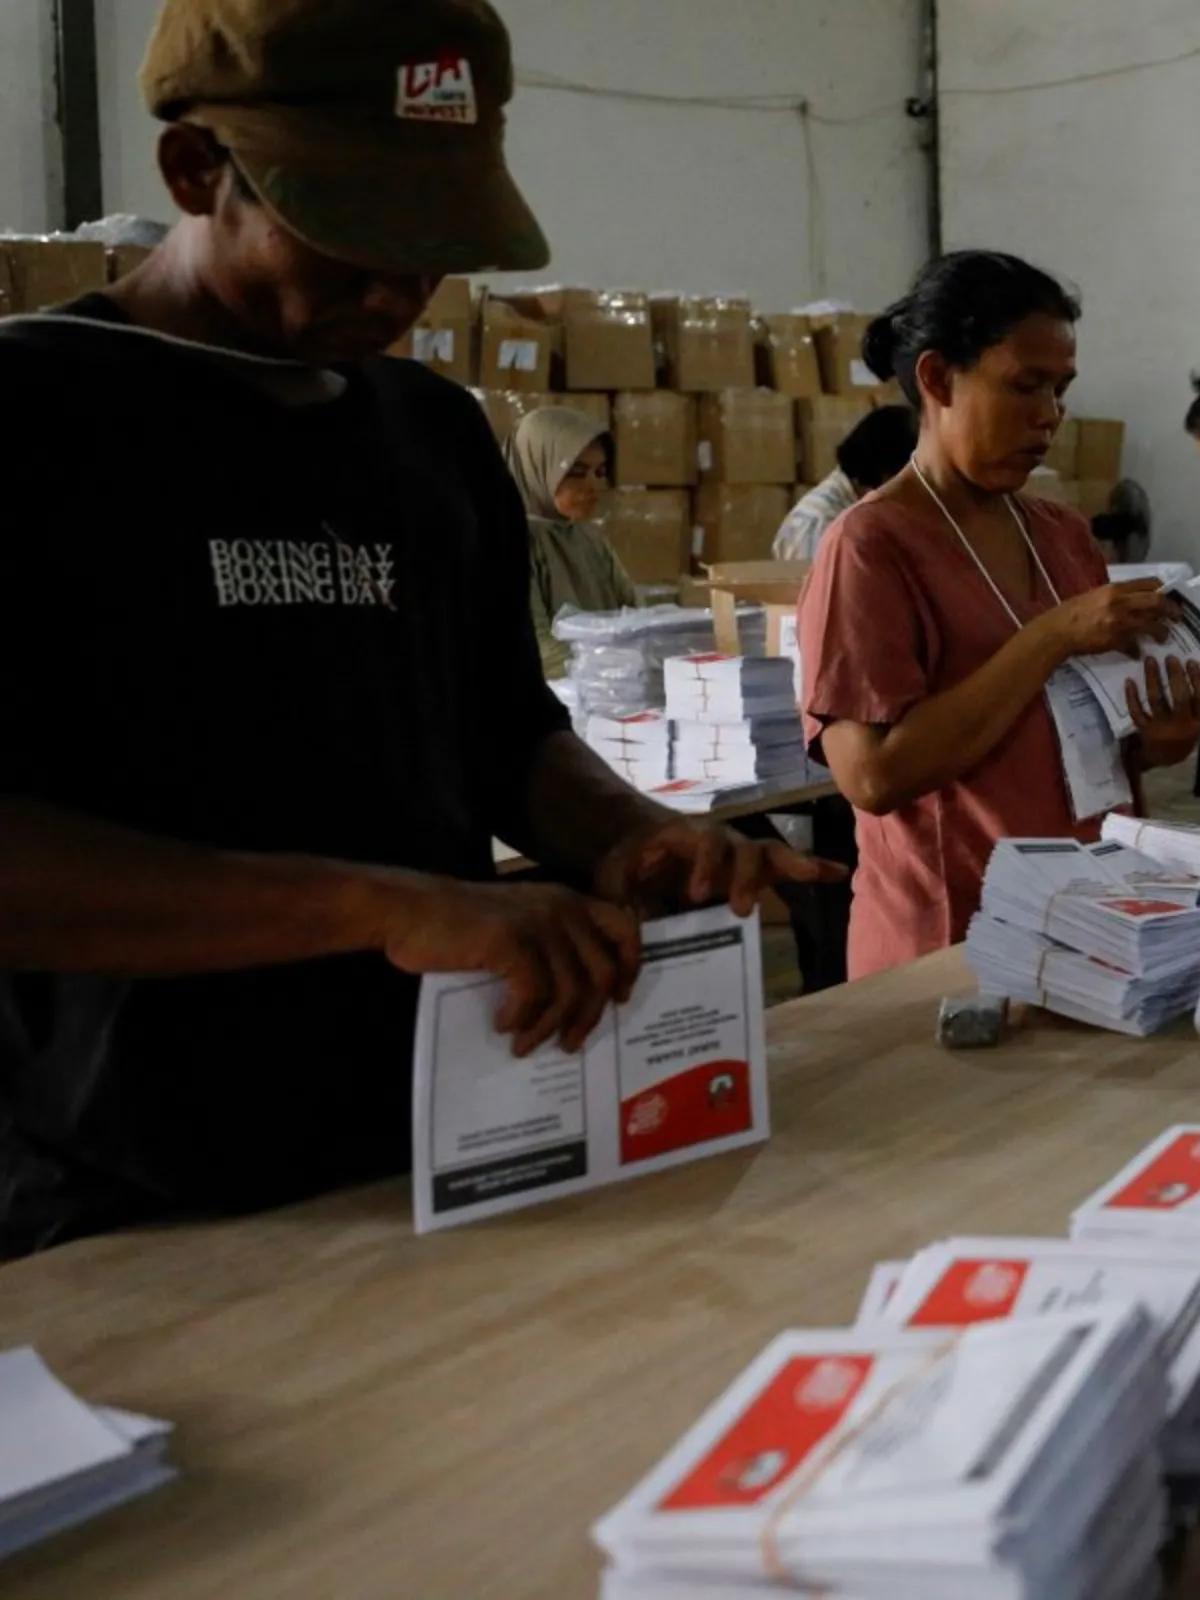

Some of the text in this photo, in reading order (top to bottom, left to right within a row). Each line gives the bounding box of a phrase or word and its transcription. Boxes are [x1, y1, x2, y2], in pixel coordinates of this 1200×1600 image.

[209, 539, 392, 567] BOXING DAY
[213, 561, 394, 586] BOXING DAY
[216, 579, 395, 605] BOXING DAY
